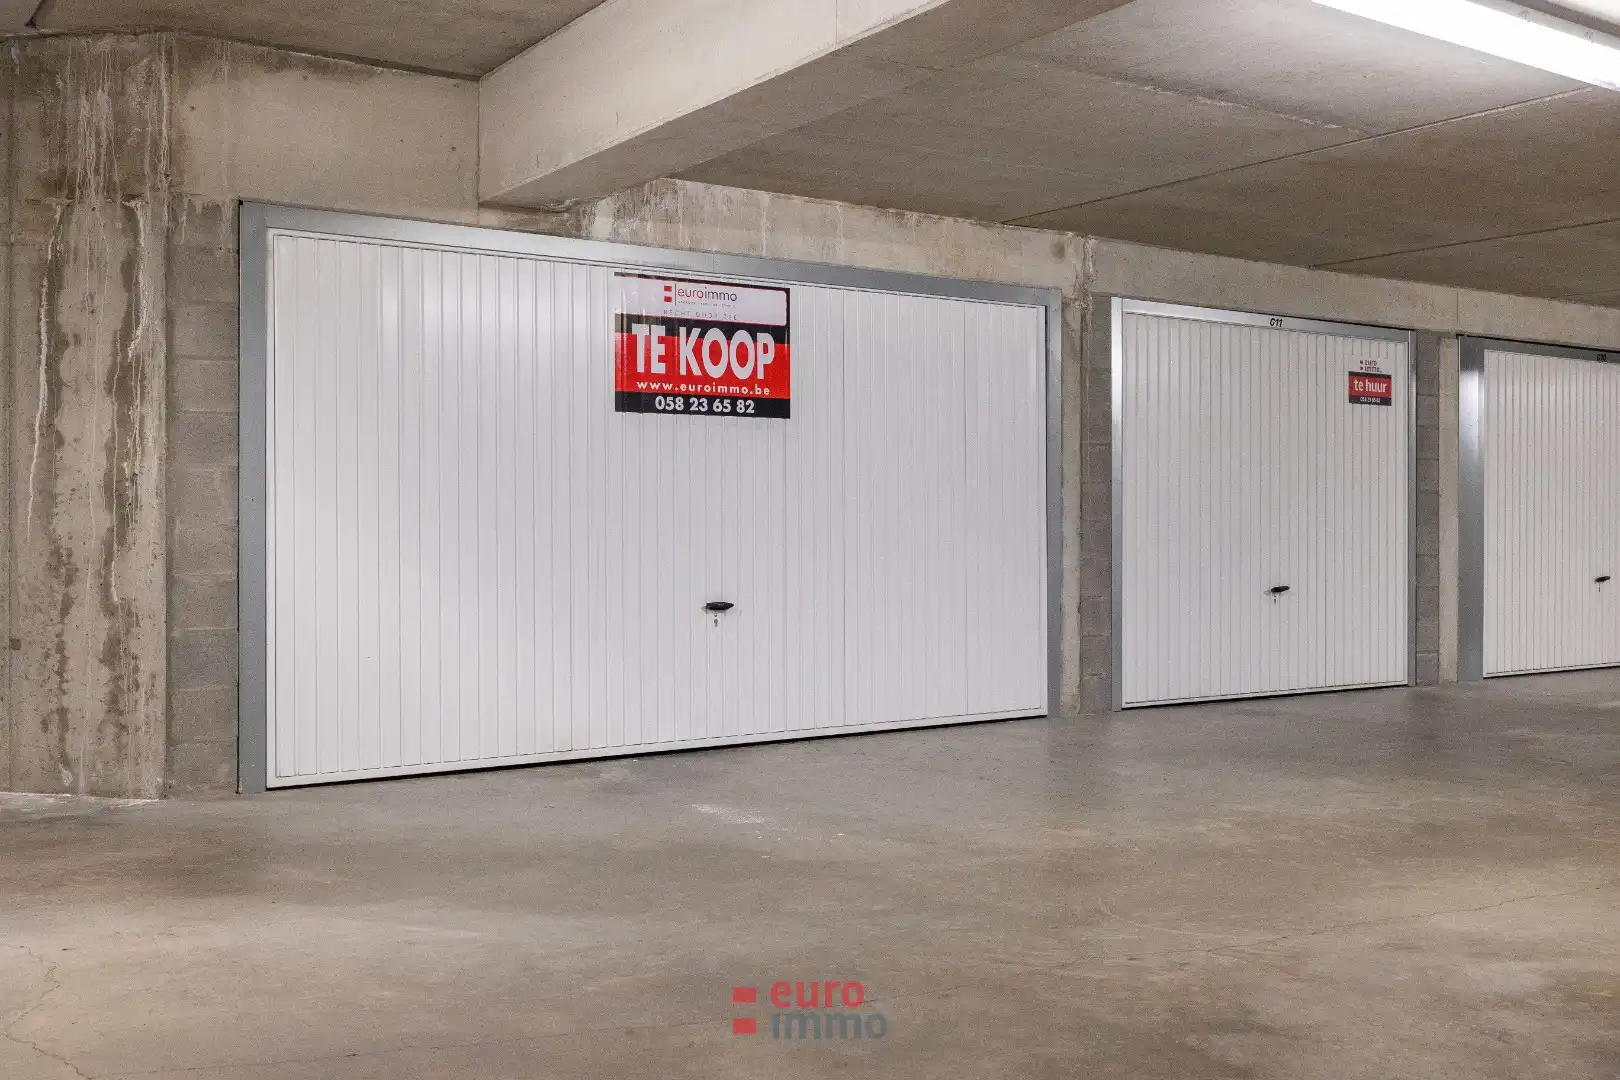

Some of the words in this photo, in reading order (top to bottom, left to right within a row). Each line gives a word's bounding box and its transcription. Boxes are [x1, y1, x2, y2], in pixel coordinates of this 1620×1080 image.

[677, 287, 737, 301] euroimmo
[632, 323, 666, 375] TE
[679, 326, 775, 380] KOOP
[636, 381, 771, 396] www.euroimmo.be
[1353, 378, 1364, 391] te
[1365, 378, 1387, 393] huur
[655, 395, 684, 411] 058
[689, 397, 708, 412] 23
[712, 398, 732, 413] 65
[736, 399, 755, 414] 82
